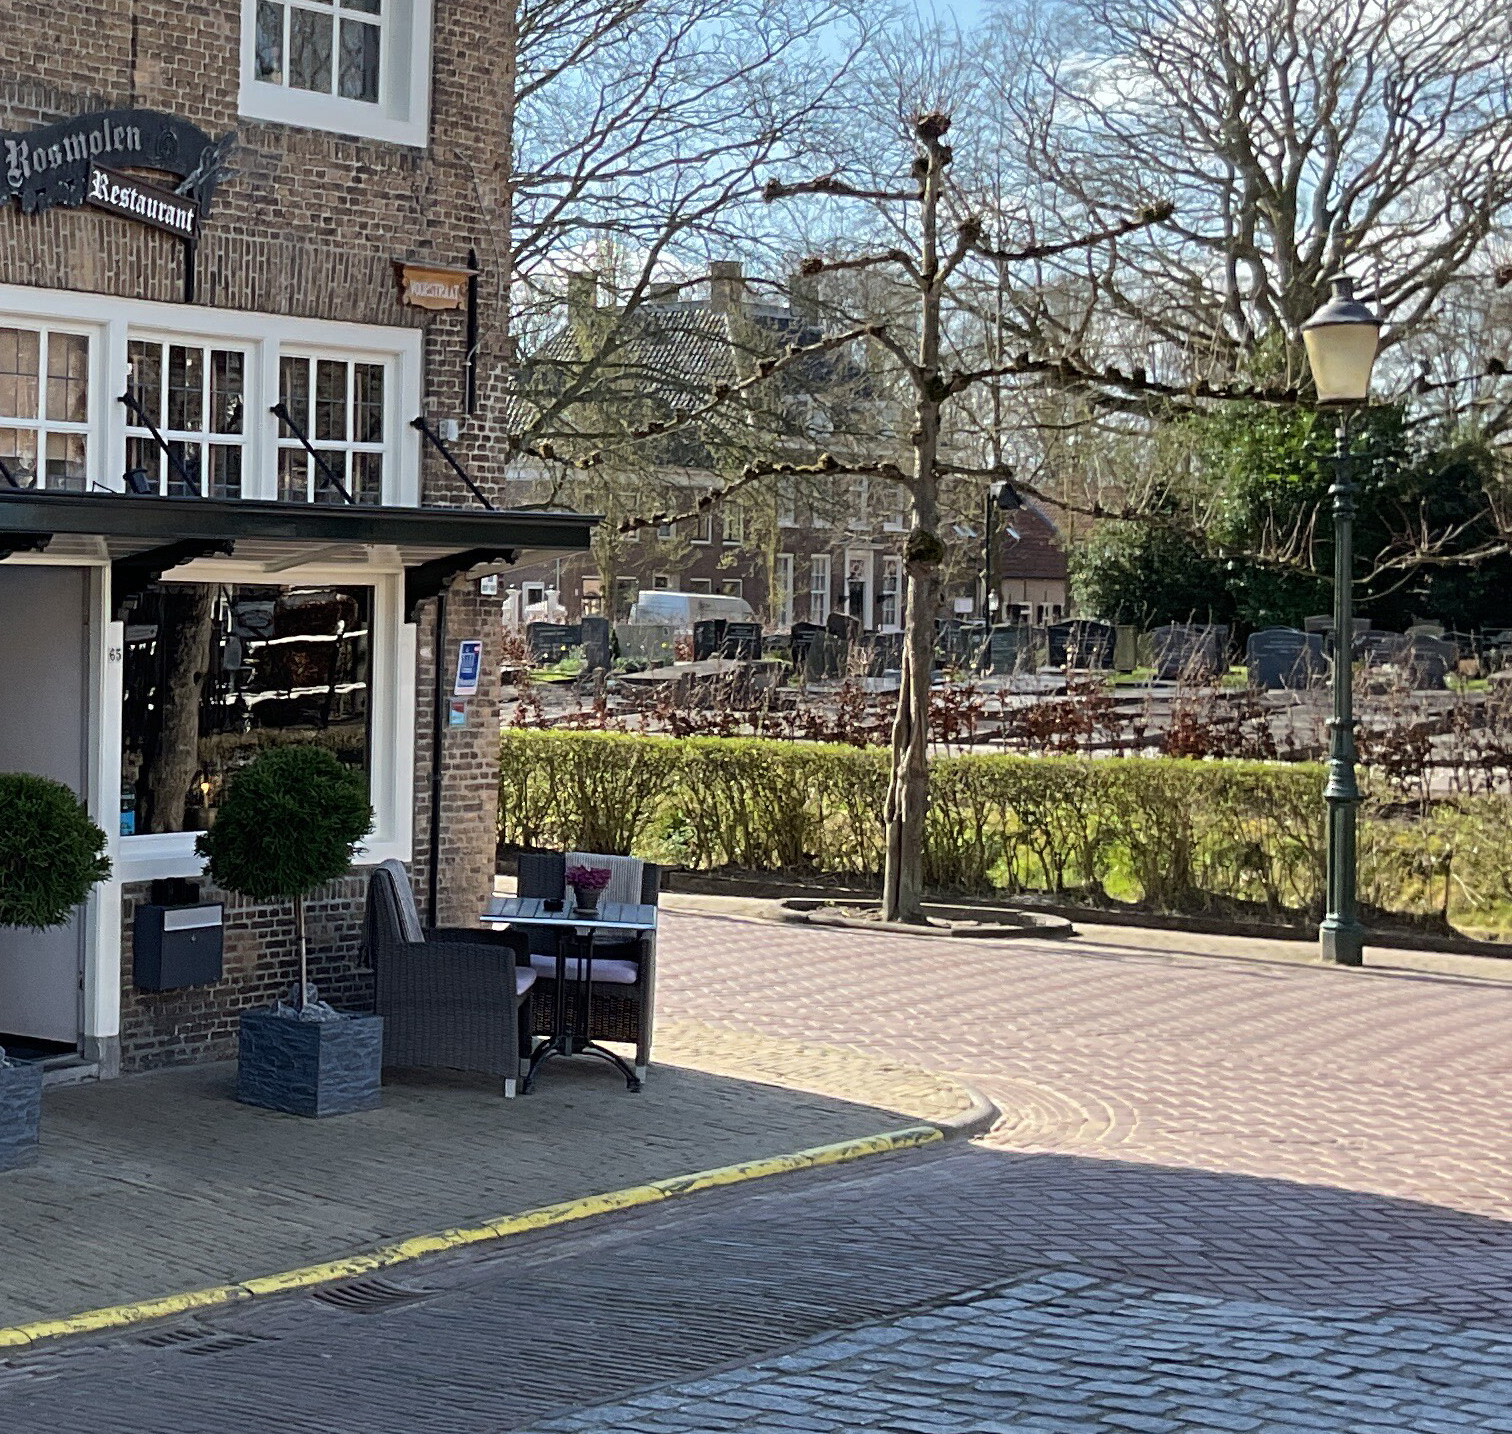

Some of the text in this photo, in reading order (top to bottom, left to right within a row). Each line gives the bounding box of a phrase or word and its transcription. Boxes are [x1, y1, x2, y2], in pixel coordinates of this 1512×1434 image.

[4, 118, 142, 188] Rosmolen
[88, 170, 195, 232] Restaurant
[109, 647, 122, 662] 65
